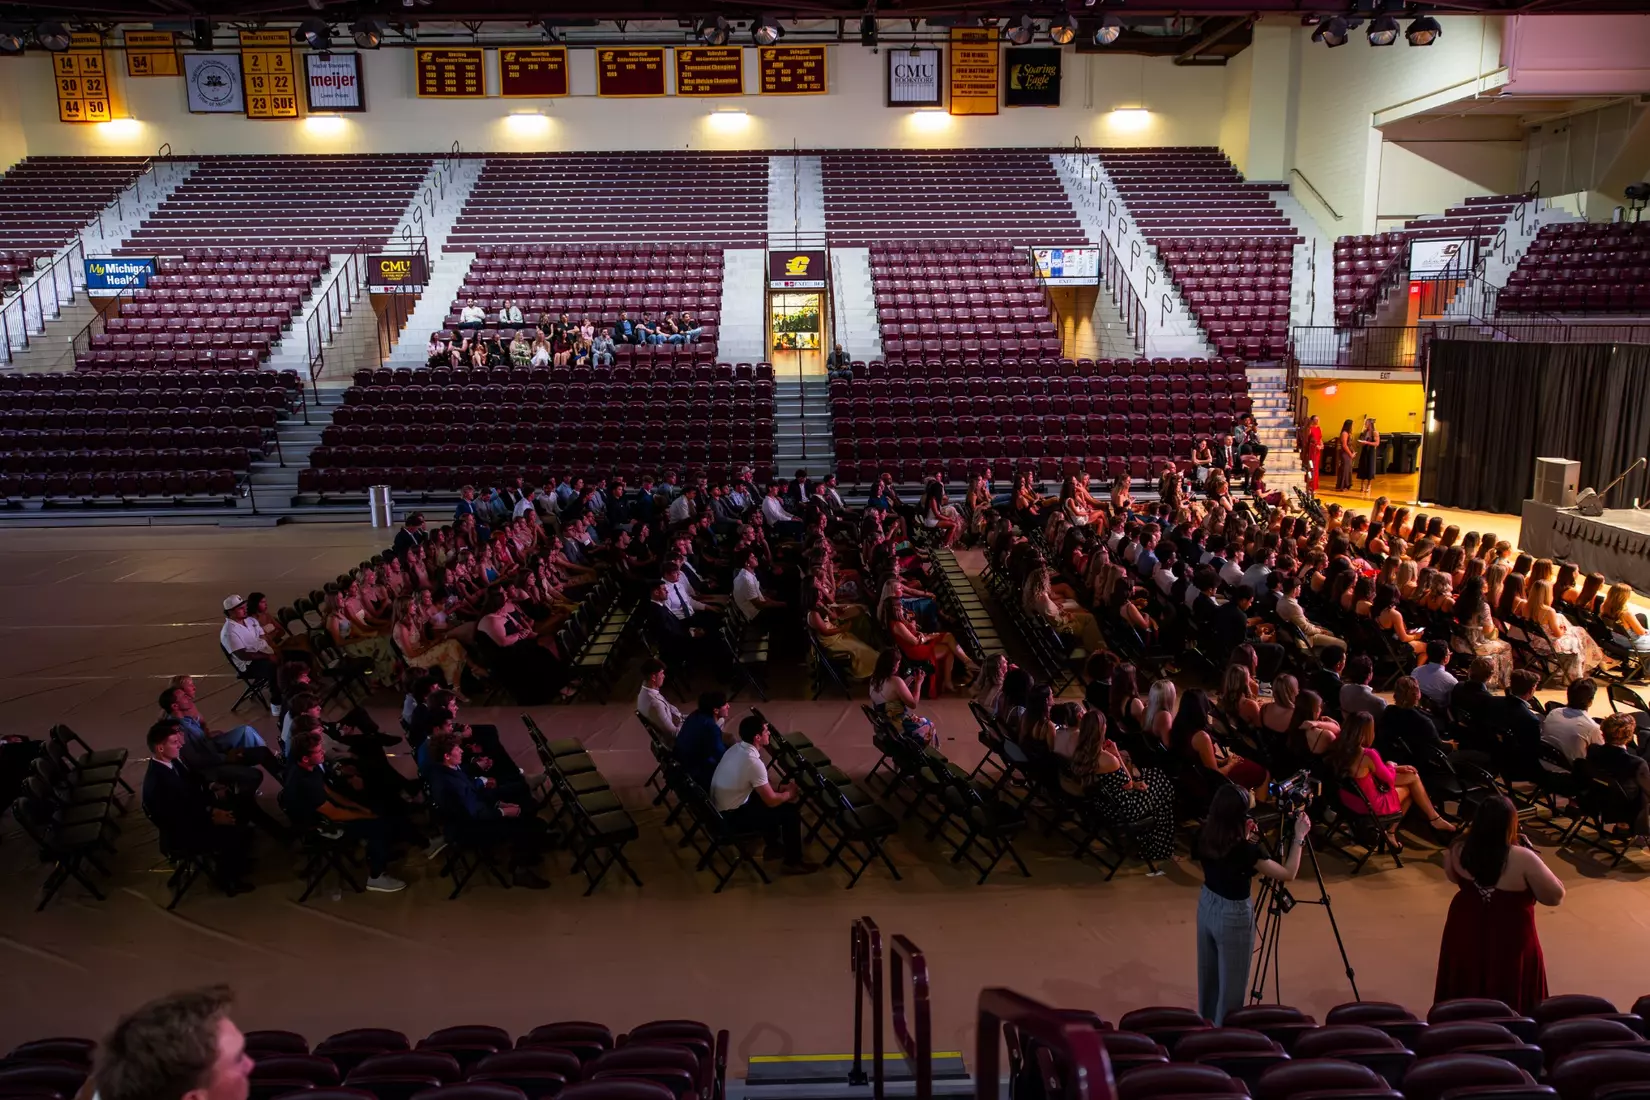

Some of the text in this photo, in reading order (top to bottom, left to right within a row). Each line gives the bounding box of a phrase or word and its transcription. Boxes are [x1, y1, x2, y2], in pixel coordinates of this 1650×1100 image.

[60, 57, 73, 69] 14
[85, 57, 97, 69] 14
[133, 56, 147, 68] 54
[251, 55, 259, 67] 2
[275, 55, 283, 66] 3
[895, 64, 934, 78] CMU
[1024, 63, 1057, 76] Soaring
[62, 79, 77, 91] 30
[87, 79, 101, 91] 32
[252, 77, 264, 88] 13
[274, 76, 288, 88] 22
[311, 72, 355, 89] meijer
[1025, 74, 1050, 87] Eagle
[66, 101, 79, 113] 44
[89, 101, 104, 113] 50
[252, 98, 267, 109] 23
[273, 98, 294, 109] SUE
[380, 260, 412, 272] CMU
[106, 275, 139, 285] Health
[1380, 372, 1391, 380] EXIT
